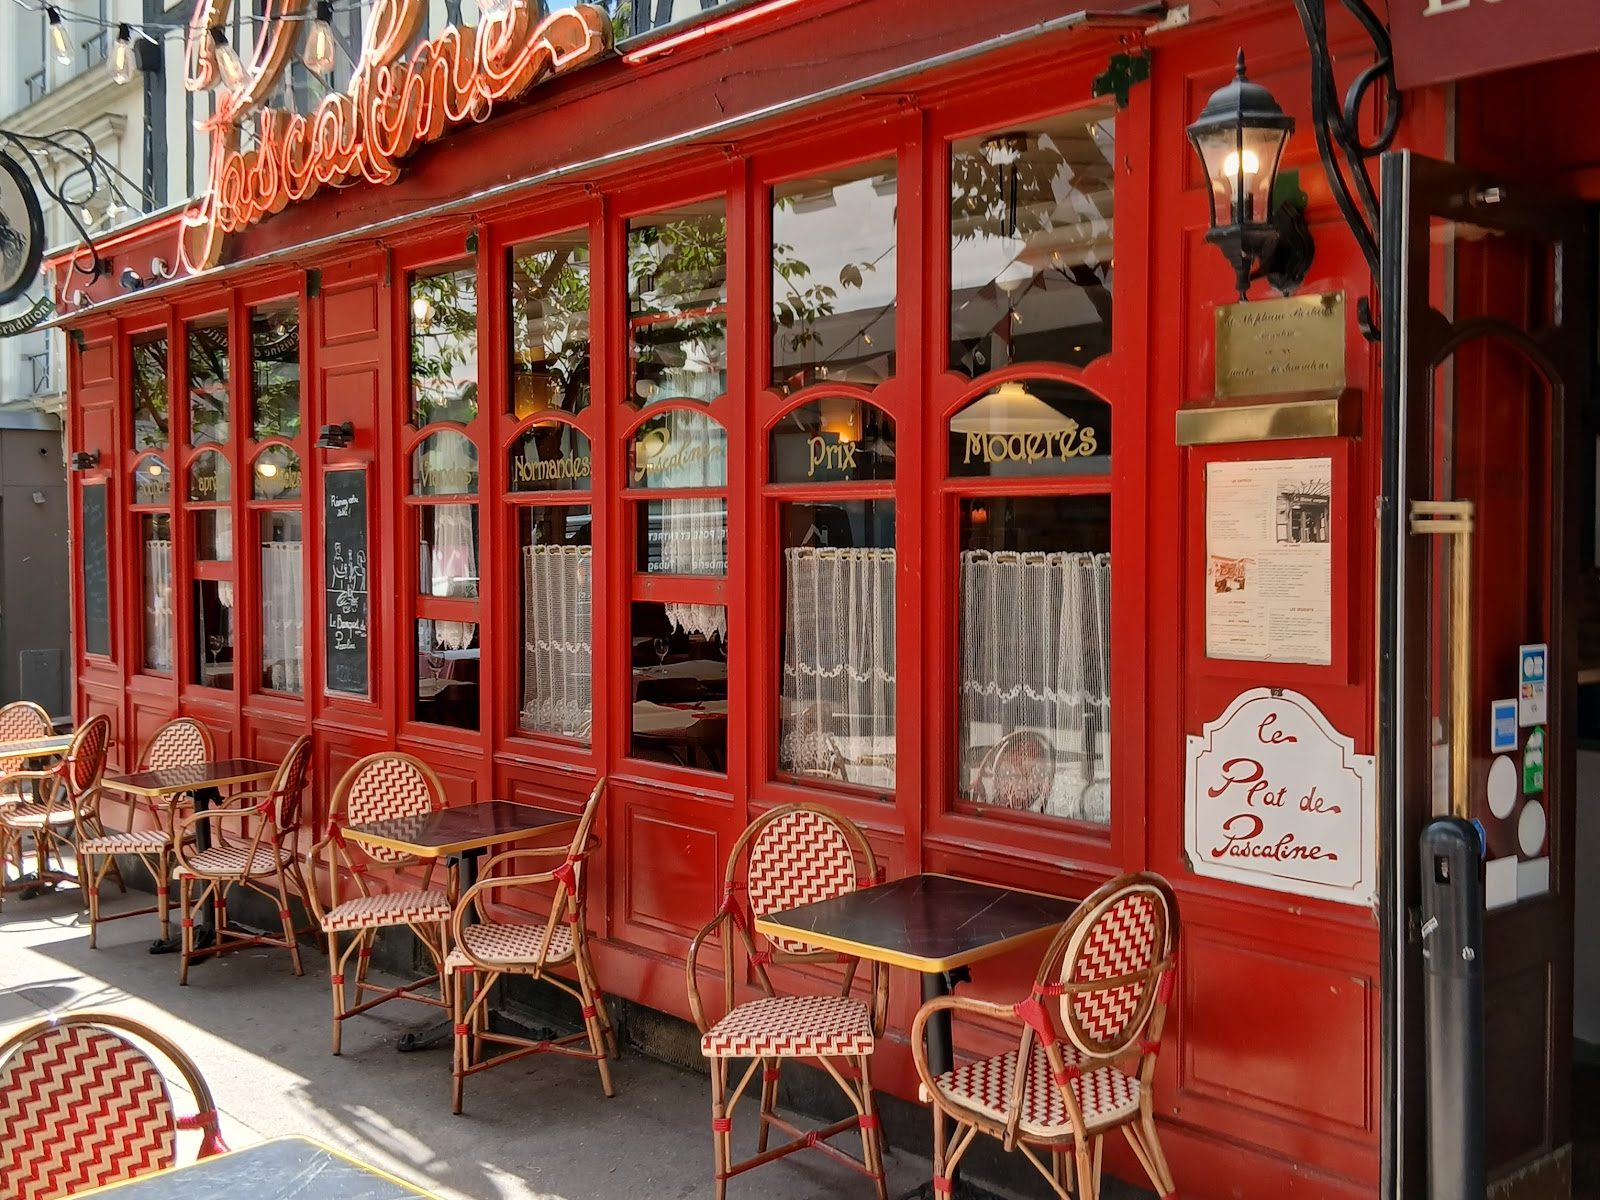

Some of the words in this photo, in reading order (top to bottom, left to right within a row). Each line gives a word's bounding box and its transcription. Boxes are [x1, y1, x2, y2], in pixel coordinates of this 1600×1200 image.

[513, 449, 591, 482] Normandes
[807, 436, 857, 477] Prix
[1257, 712, 1298, 744] le
[1207, 758, 1288, 807] Plat
[1299, 786, 1342, 814] de
[1211, 813, 1338, 862] Pascaline
